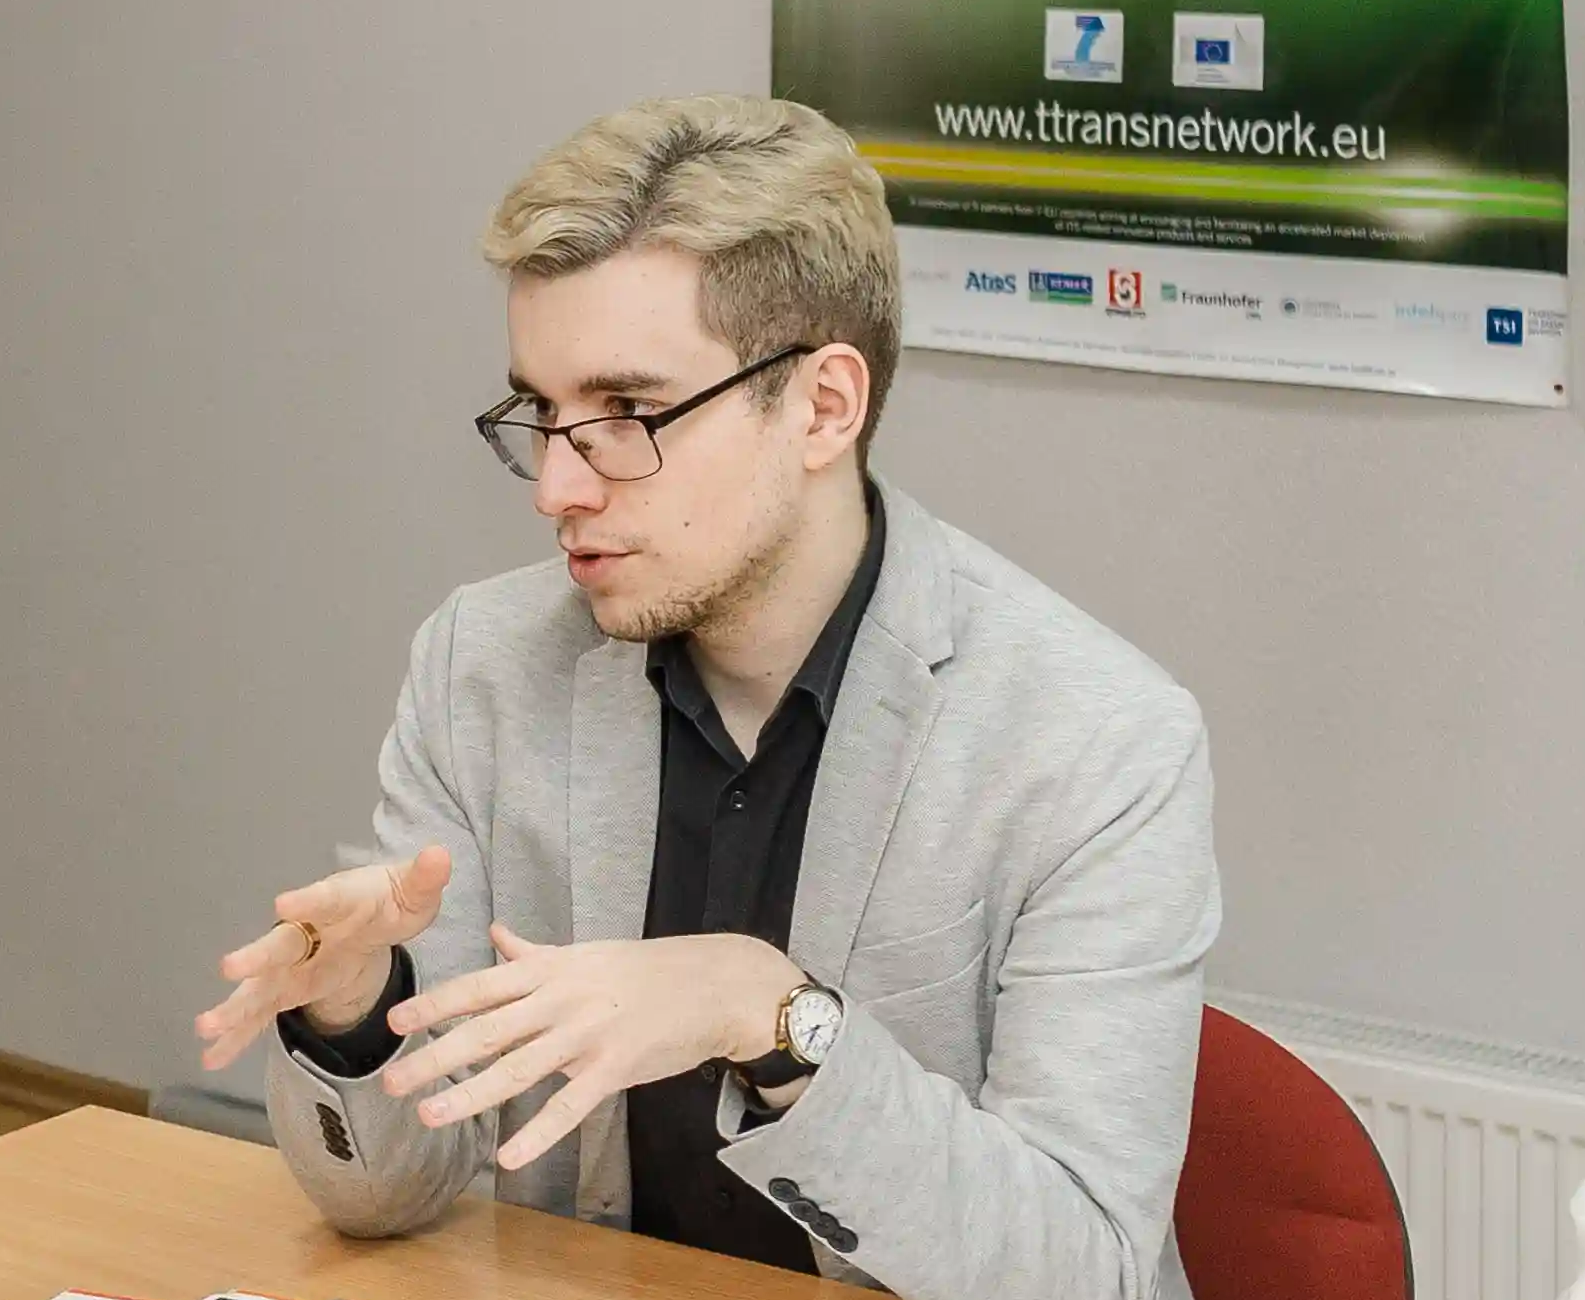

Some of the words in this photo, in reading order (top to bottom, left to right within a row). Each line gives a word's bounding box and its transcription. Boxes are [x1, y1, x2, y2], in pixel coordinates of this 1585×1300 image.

[934, 100, 1386, 161] www.ttransnetwork.eu
[1181, 289, 1263, 312] Fraunhofer
[1493, 317, 1517, 337] TSI
